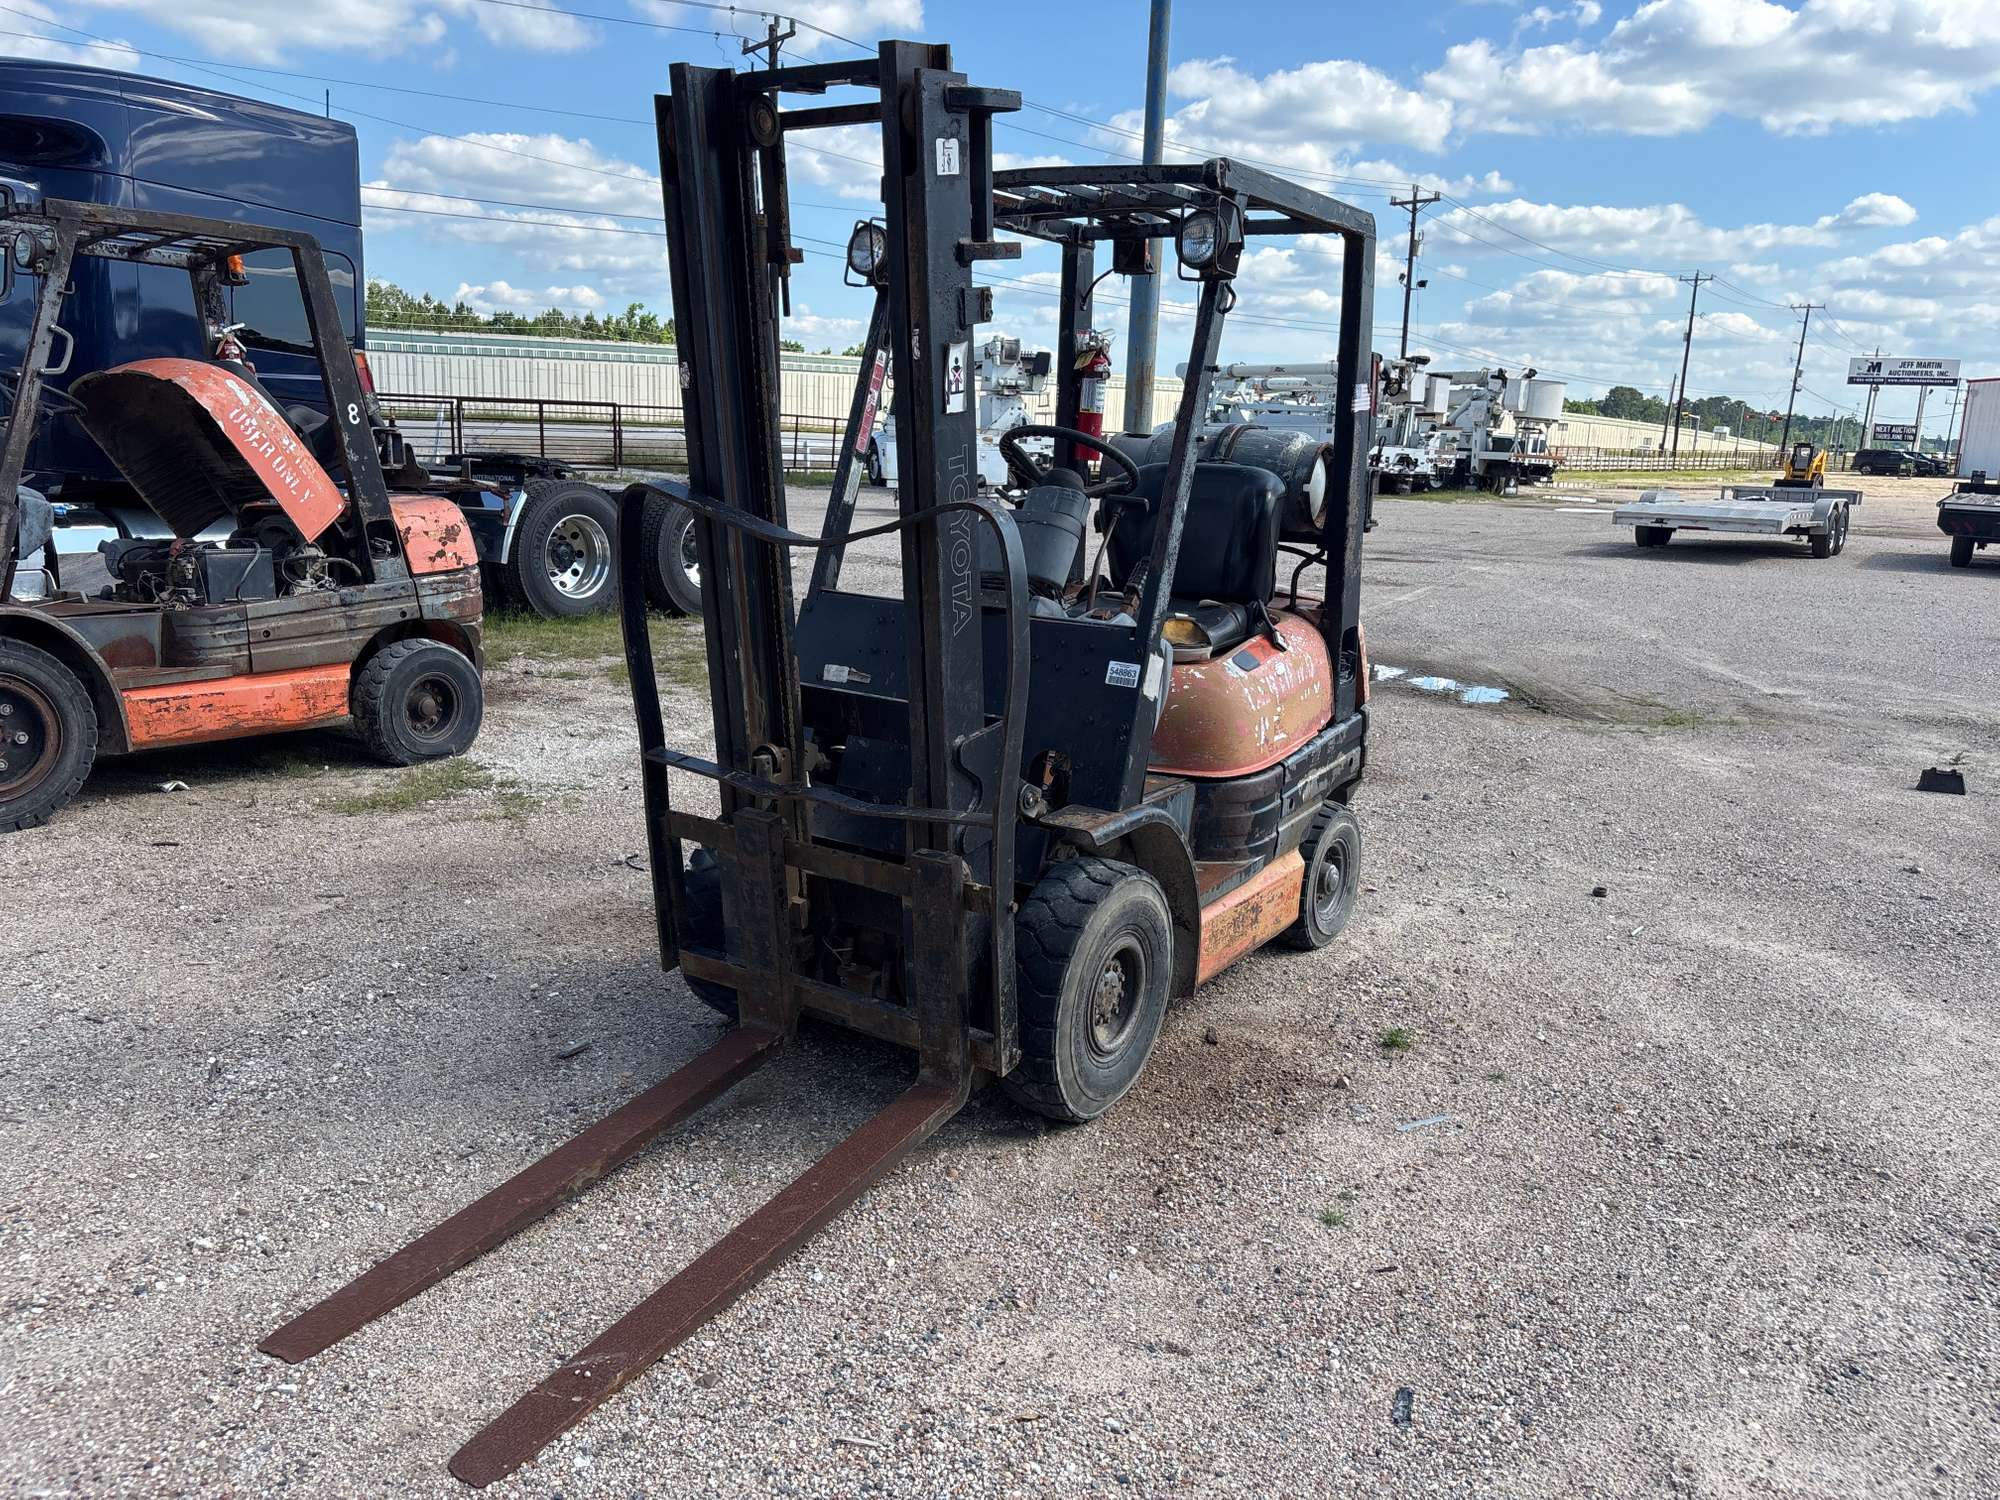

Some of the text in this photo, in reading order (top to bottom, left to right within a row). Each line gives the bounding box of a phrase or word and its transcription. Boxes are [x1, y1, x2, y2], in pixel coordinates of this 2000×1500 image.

[1898, 361, 1942, 369] JEFF MARTIN
[347, 403, 361, 424] 8
[1875, 425, 1916, 434] NEXT AUCTION
[228, 406, 276, 459] USER
[271, 456, 316, 503] ONLY
[948, 443, 973, 637] TOYOTA
